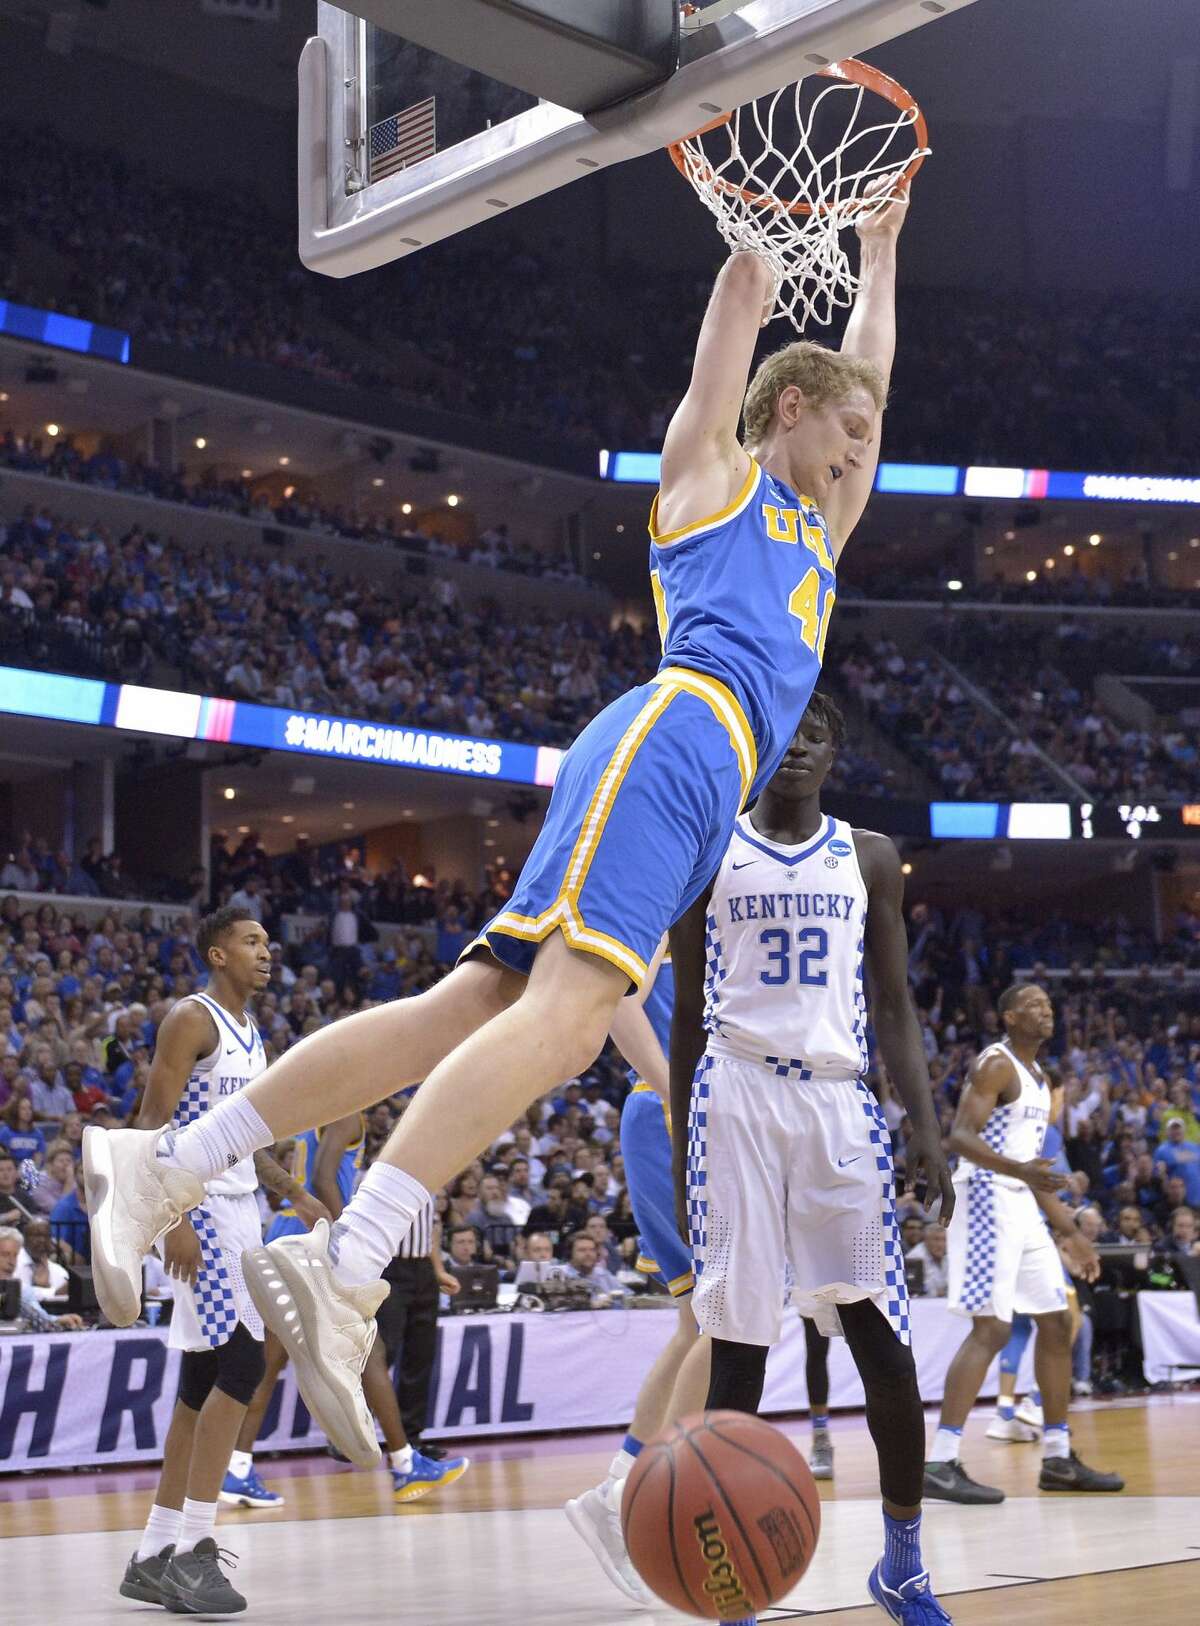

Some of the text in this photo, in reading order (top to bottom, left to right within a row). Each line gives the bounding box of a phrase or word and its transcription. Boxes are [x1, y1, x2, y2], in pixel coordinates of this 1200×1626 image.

[285, 715, 501, 774] #MARCHMADNESS
[728, 893, 856, 923] KENTUCKY
[759, 927, 829, 986] 32
